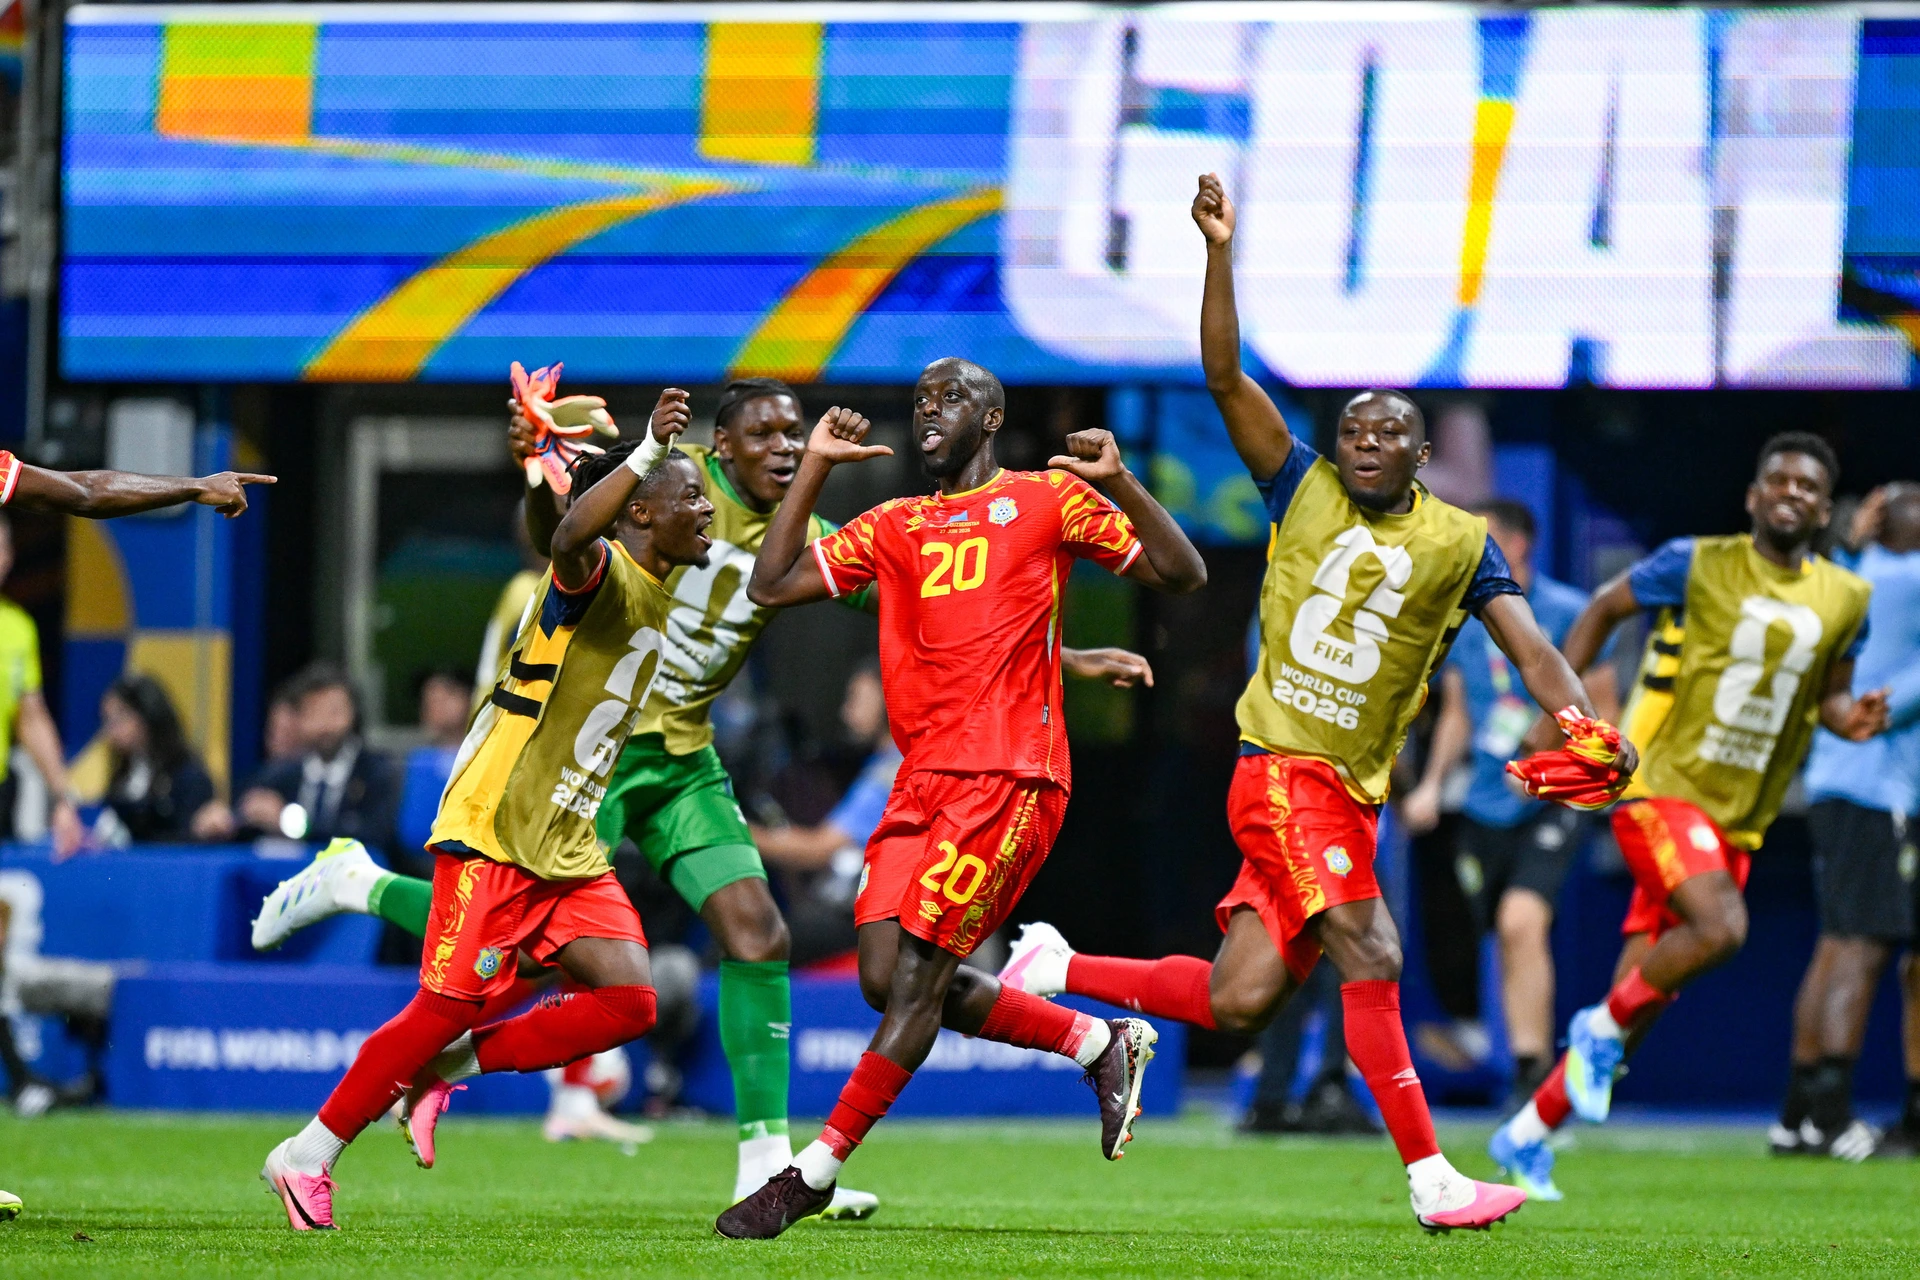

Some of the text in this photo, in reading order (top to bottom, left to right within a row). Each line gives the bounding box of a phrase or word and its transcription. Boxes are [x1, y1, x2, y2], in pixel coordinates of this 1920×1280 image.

[1001, 9, 1909, 388] GOAL
[921, 536, 989, 598] 20
[1312, 640, 1355, 669] FIFA
[1272, 679, 1360, 731] 2026
[1280, 662, 1367, 706] WORLD CUP
[919, 840, 987, 904] 20
